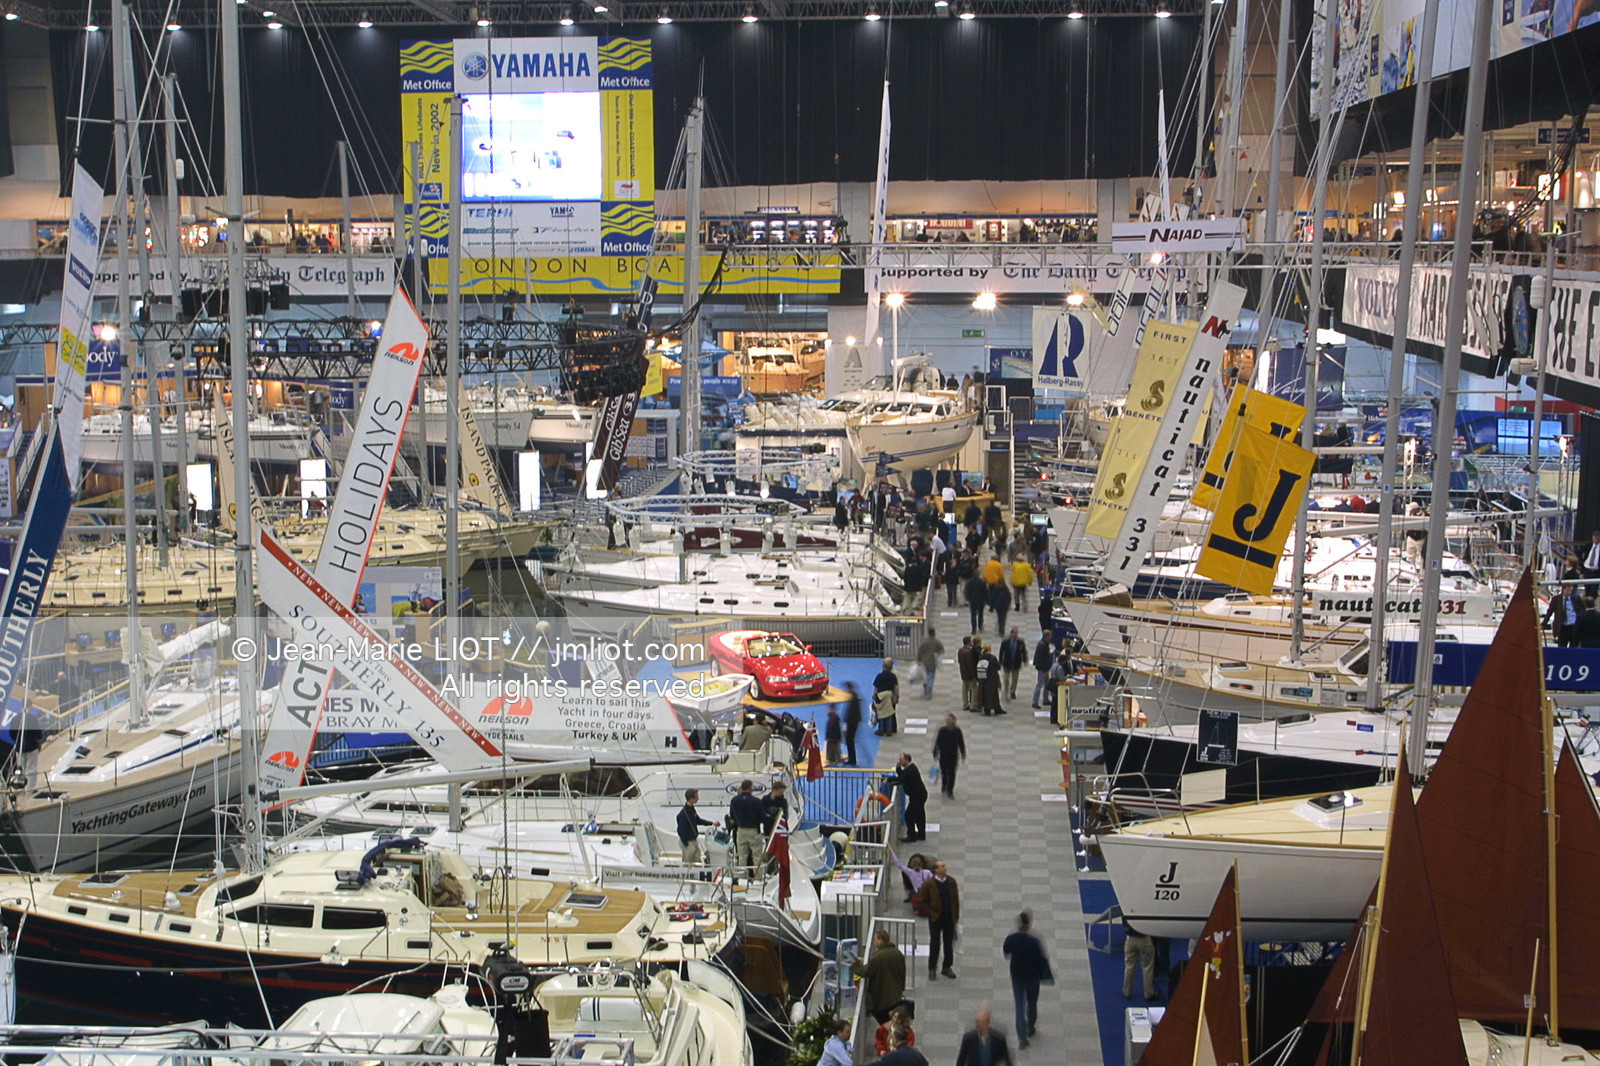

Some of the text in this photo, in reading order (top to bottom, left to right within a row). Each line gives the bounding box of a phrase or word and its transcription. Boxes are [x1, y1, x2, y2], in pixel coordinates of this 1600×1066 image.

[492, 53, 591, 78] YAMAHA
[403, 79, 452, 90] Met Office
[600, 76, 650, 88] Met Office
[430, 104, 441, 173] New in 2002
[604, 242, 652, 252] Met Office
[462, 258, 587, 273] ONDON
[880, 267, 989, 279] Supported by
[1003, 261, 1040, 279] The
[1048, 261, 1098, 283] Daily
[298, 264, 384, 285] Telegaph
[1153, 330, 1187, 344] FIRST
[1038, 376, 1084, 388] Hallberg-Rassy
[1124, 410, 1163, 422] BENETE
[610, 418, 630, 461] Gib'Sea
[462, 406, 509, 508] ISLAND PACKET
[328, 396, 404, 574] HOLIDAYS
[1233, 469, 1302, 542] J
[1118, 518, 1148, 571] 331
[293, 566, 481, 740] NEW NEW NEW NEW NEW NEW
[288, 604, 445, 748] SOUTHERLY 135
[1545, 664, 1590, 682] 109
[562, 696, 650, 708] Learn to sail this
[326, 716, 374, 727] BRAY
[558, 707, 654, 721] Yacht in four days.
[565, 718, 646, 731] Greece, Croatia
[572, 730, 638, 742] Turkey & UK
[72, 784, 207, 834] YachtingGateway.com
[1160, 862, 1178, 884] J
[1154, 889, 1180, 901] 120
